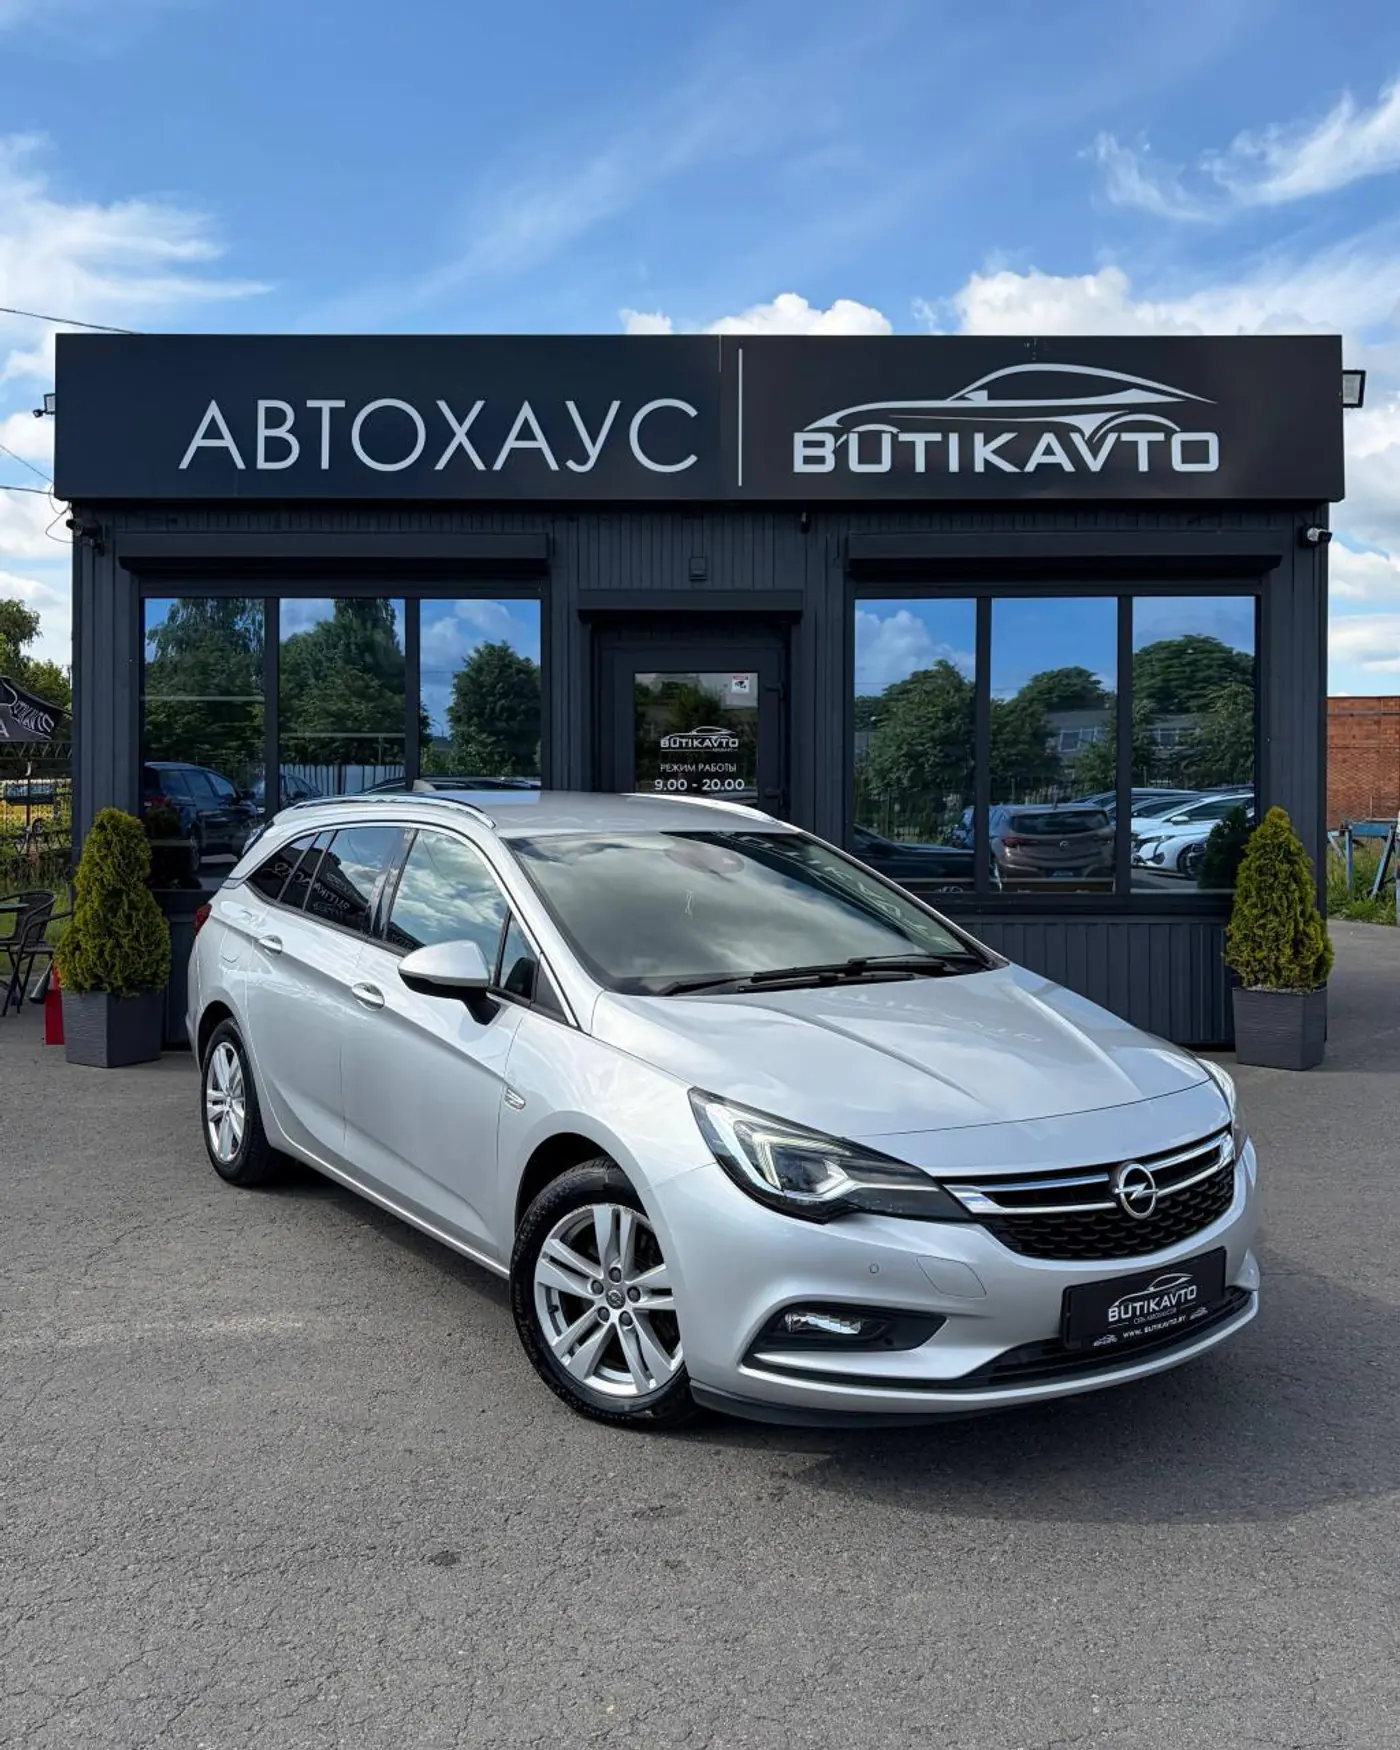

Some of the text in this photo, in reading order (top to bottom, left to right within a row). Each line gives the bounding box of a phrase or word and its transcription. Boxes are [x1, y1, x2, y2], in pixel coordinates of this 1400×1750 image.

[179, 398, 699, 473] АВТОХАУС
[793, 431, 1220, 473] BUTIKAVTO
[660, 738, 739, 748] BUTIKAVTO
[660, 763, 737, 772] РЕЖИМ РАБОТЫ
[655, 779, 688, 790] 9.00
[702, 779, 745, 790] 20.00
[1108, 1285, 1197, 1322] BUTIKAVTO
